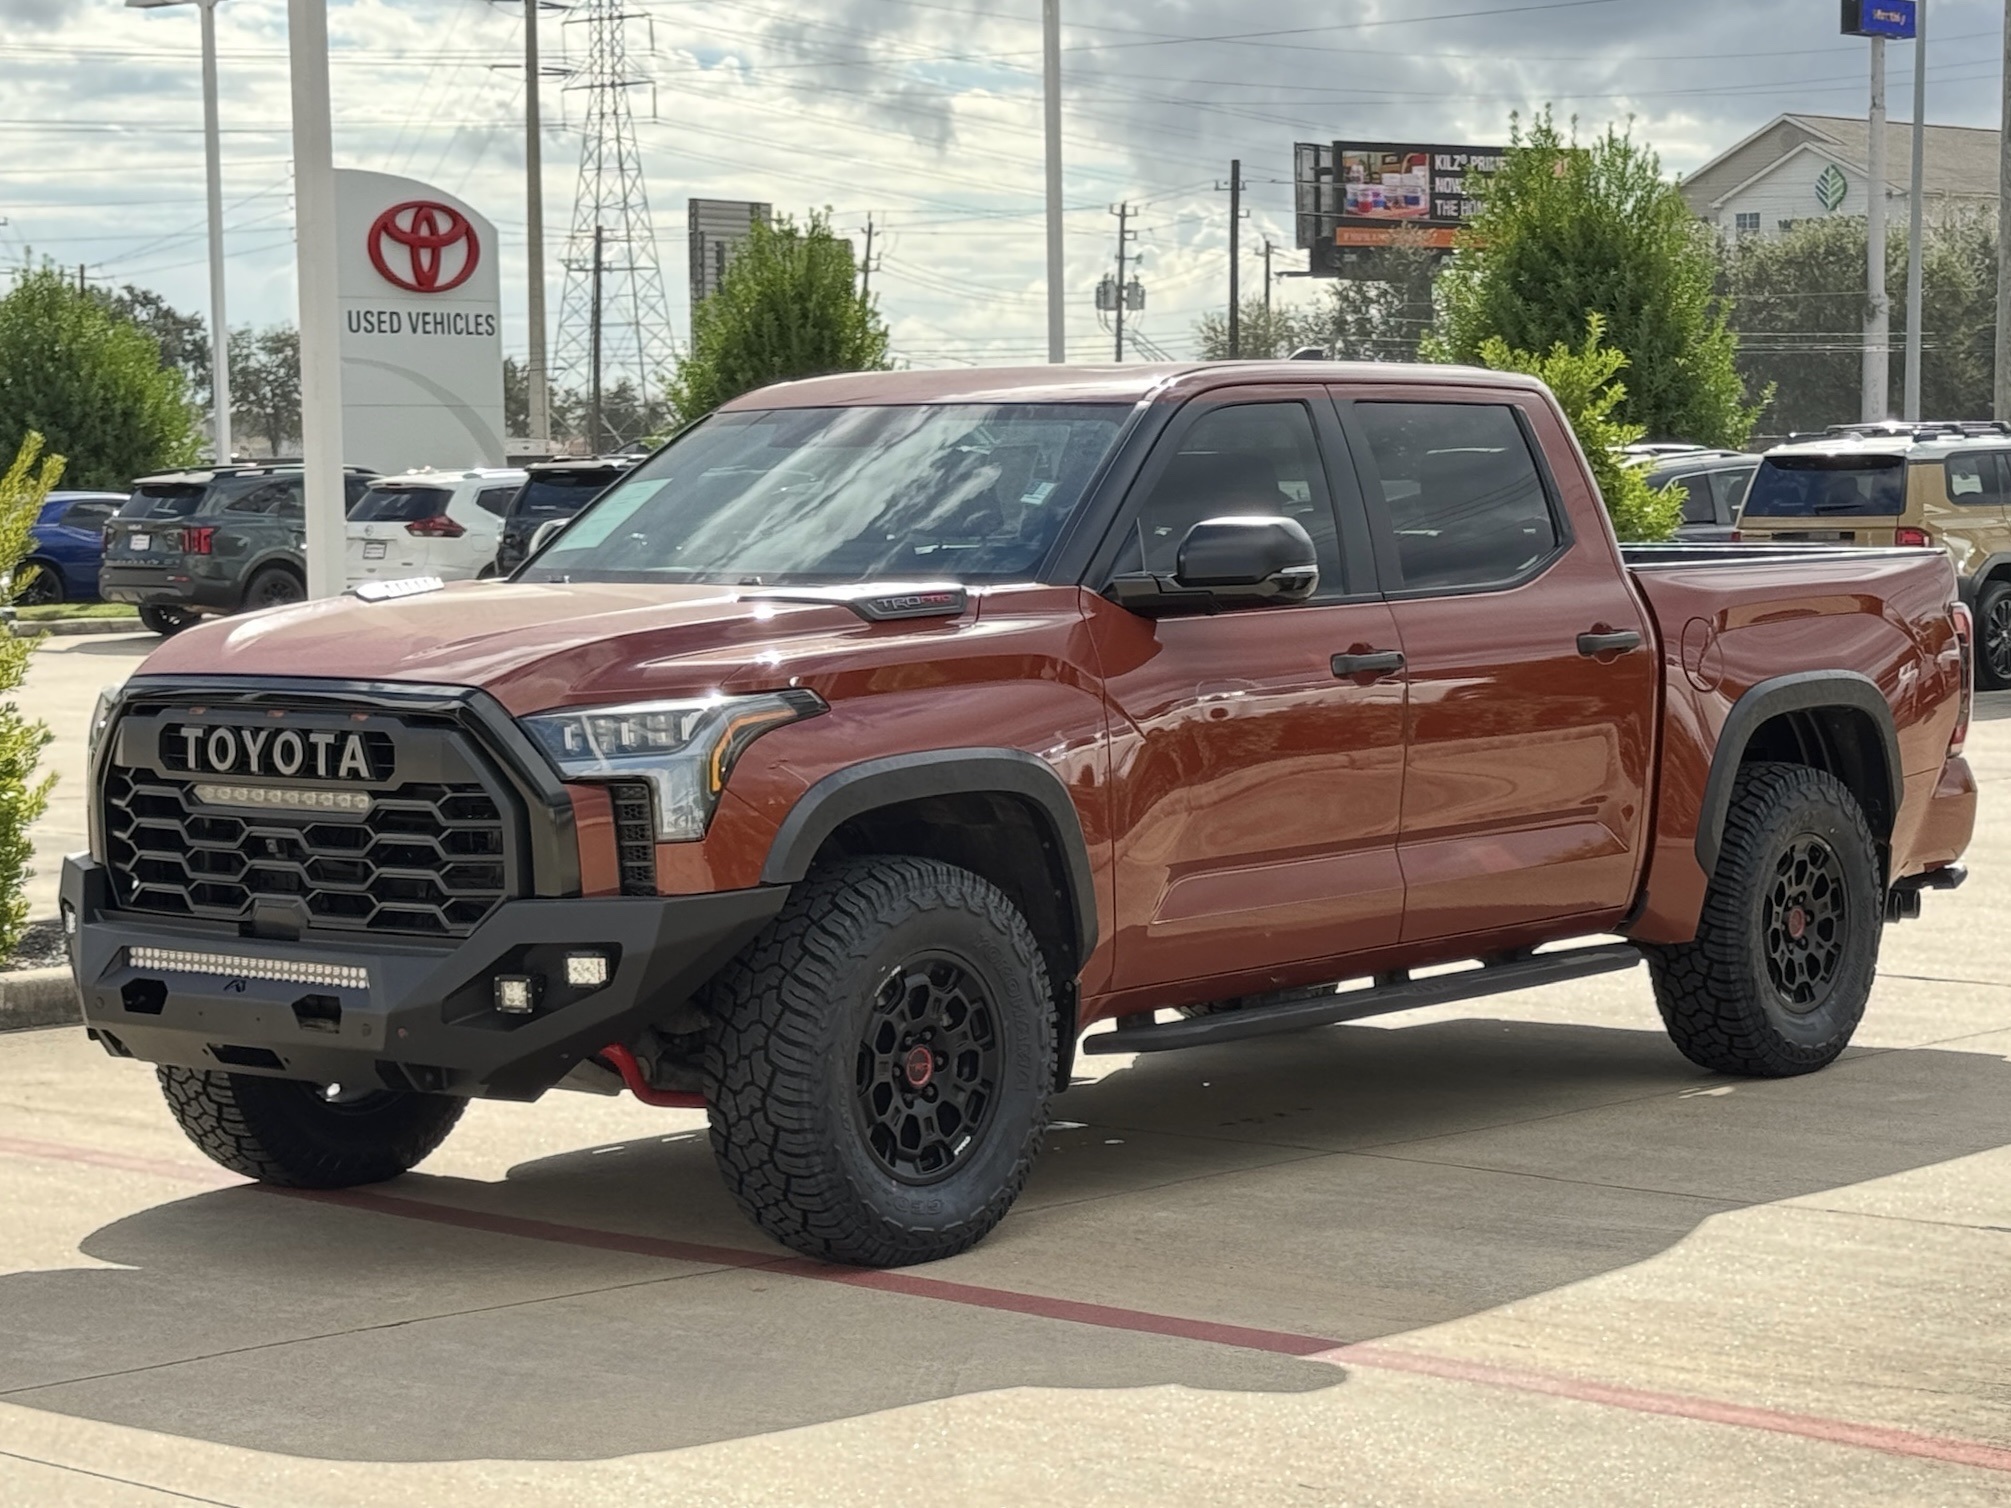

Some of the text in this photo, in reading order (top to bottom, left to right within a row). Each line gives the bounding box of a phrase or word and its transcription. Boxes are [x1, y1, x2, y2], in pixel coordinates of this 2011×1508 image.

[1434, 199, 1459, 216] THE
[347, 310, 496, 336] USED VEHICLES
[180, 726, 373, 779] TOYOTA
[974, 933, 1032, 1091] YOKOHAMA
